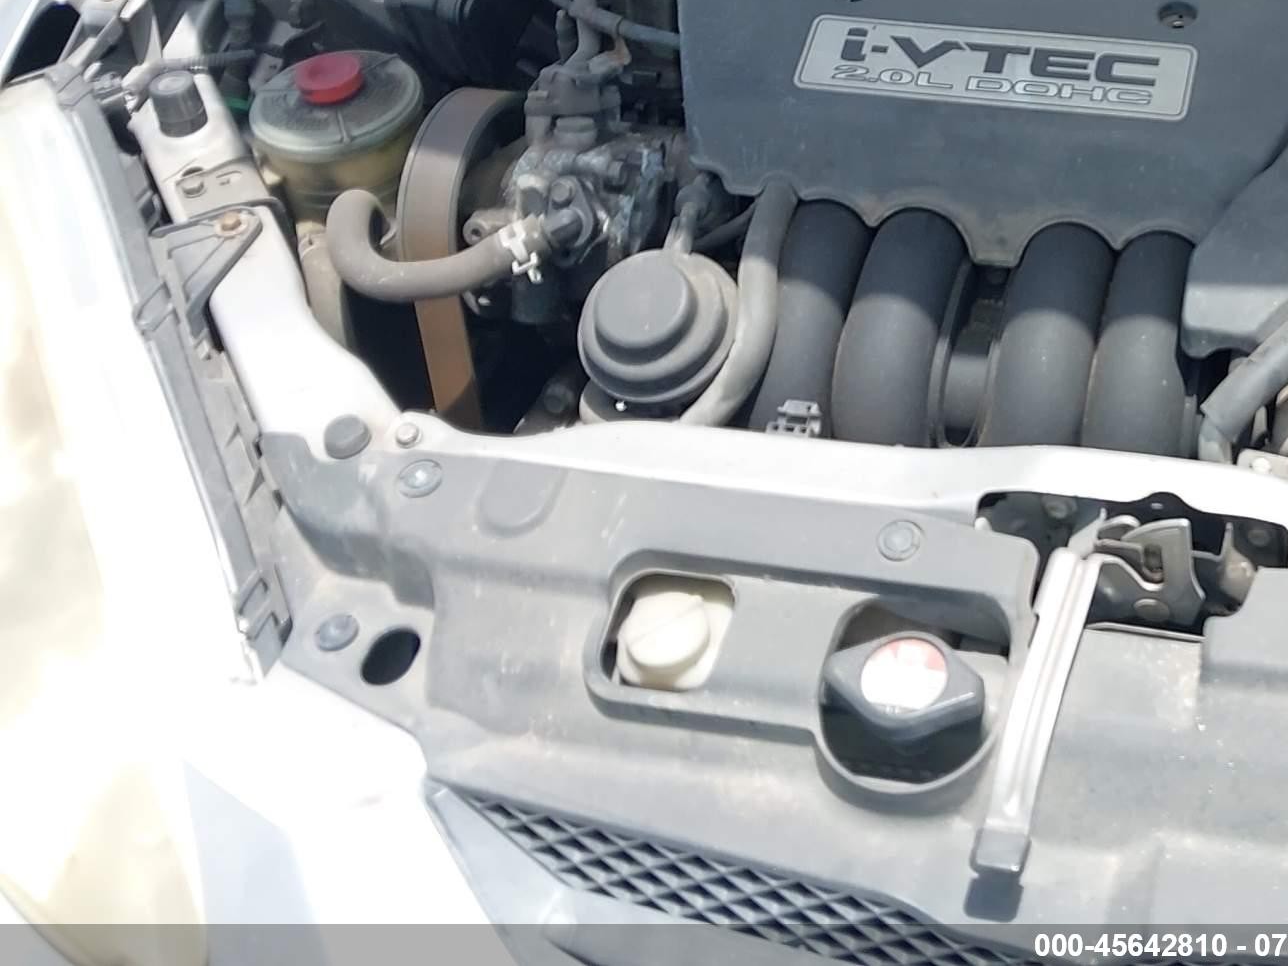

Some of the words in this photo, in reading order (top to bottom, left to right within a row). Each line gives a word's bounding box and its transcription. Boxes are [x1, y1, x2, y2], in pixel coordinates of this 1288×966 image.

[839, 26, 1161, 86] i-VTEC
[831, 65, 954, 90] 2.0L
[964, 76, 1152, 105] DOHC
